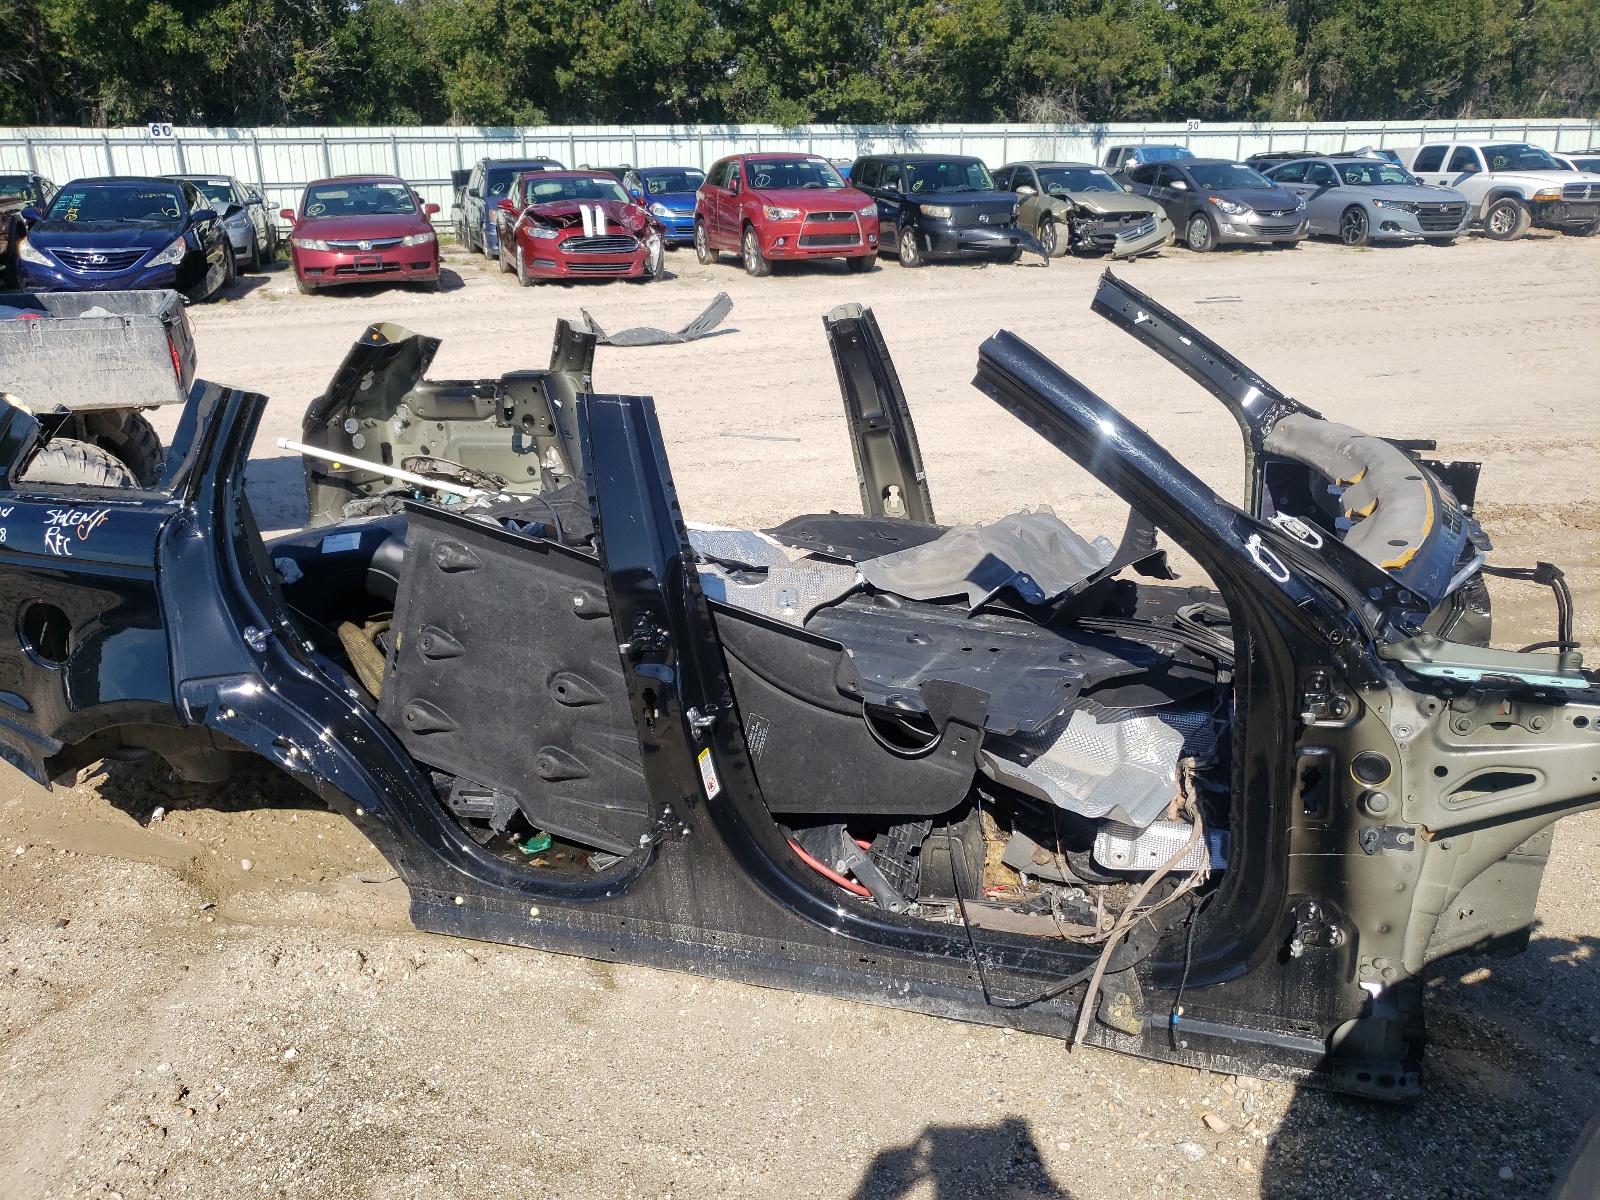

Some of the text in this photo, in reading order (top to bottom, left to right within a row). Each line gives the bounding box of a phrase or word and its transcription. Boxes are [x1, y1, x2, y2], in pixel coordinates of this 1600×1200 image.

[151, 124, 172, 137] 60
[1188, 121, 1199, 130] 50
[44, 526, 73, 556] REC
